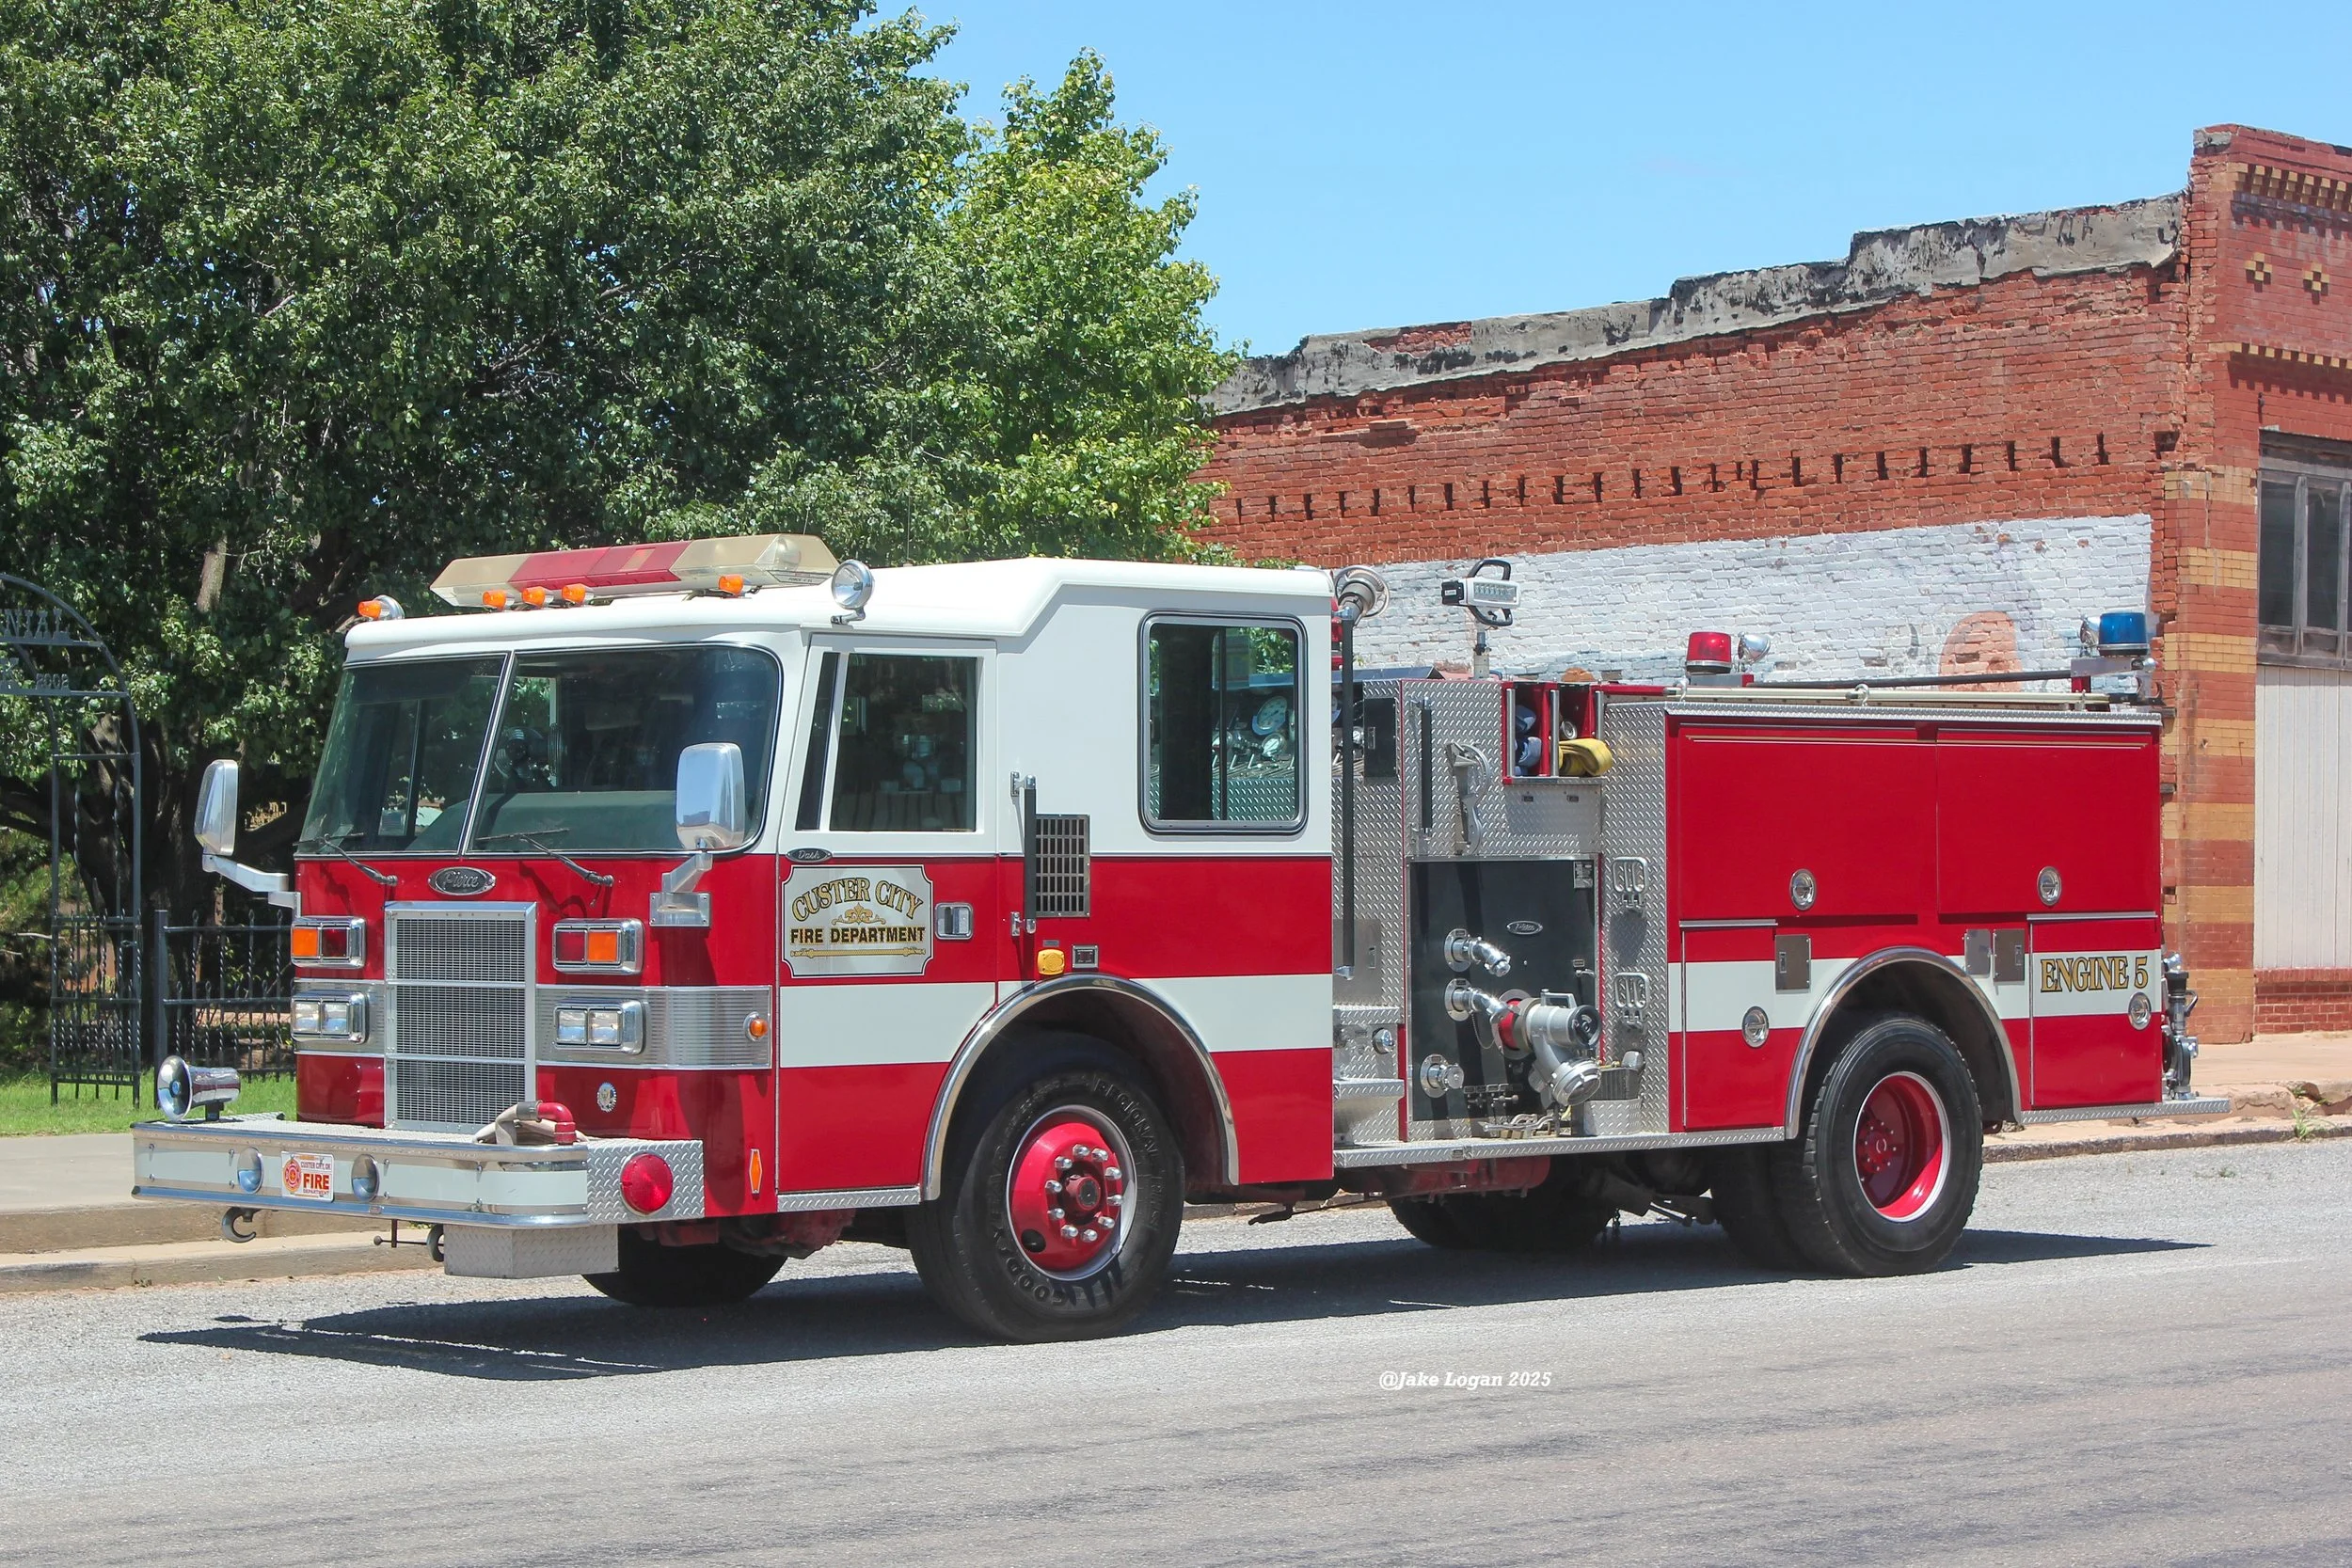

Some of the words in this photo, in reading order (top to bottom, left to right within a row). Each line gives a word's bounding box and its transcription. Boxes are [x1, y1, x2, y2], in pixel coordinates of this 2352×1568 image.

[0, 609, 71, 640] NIAL
[798, 849, 820, 860] Dash
[443, 870, 480, 891] Pierce
[791, 877, 871, 922] CUSTER
[875, 879, 924, 920] CITY
[790, 927, 824, 944] FIRE
[830, 927, 926, 944] DEPARTMENT
[2041, 956, 2129, 993] ENGINE
[2134, 956, 2149, 990] 5
[303, 1173, 329, 1189] FIRE
